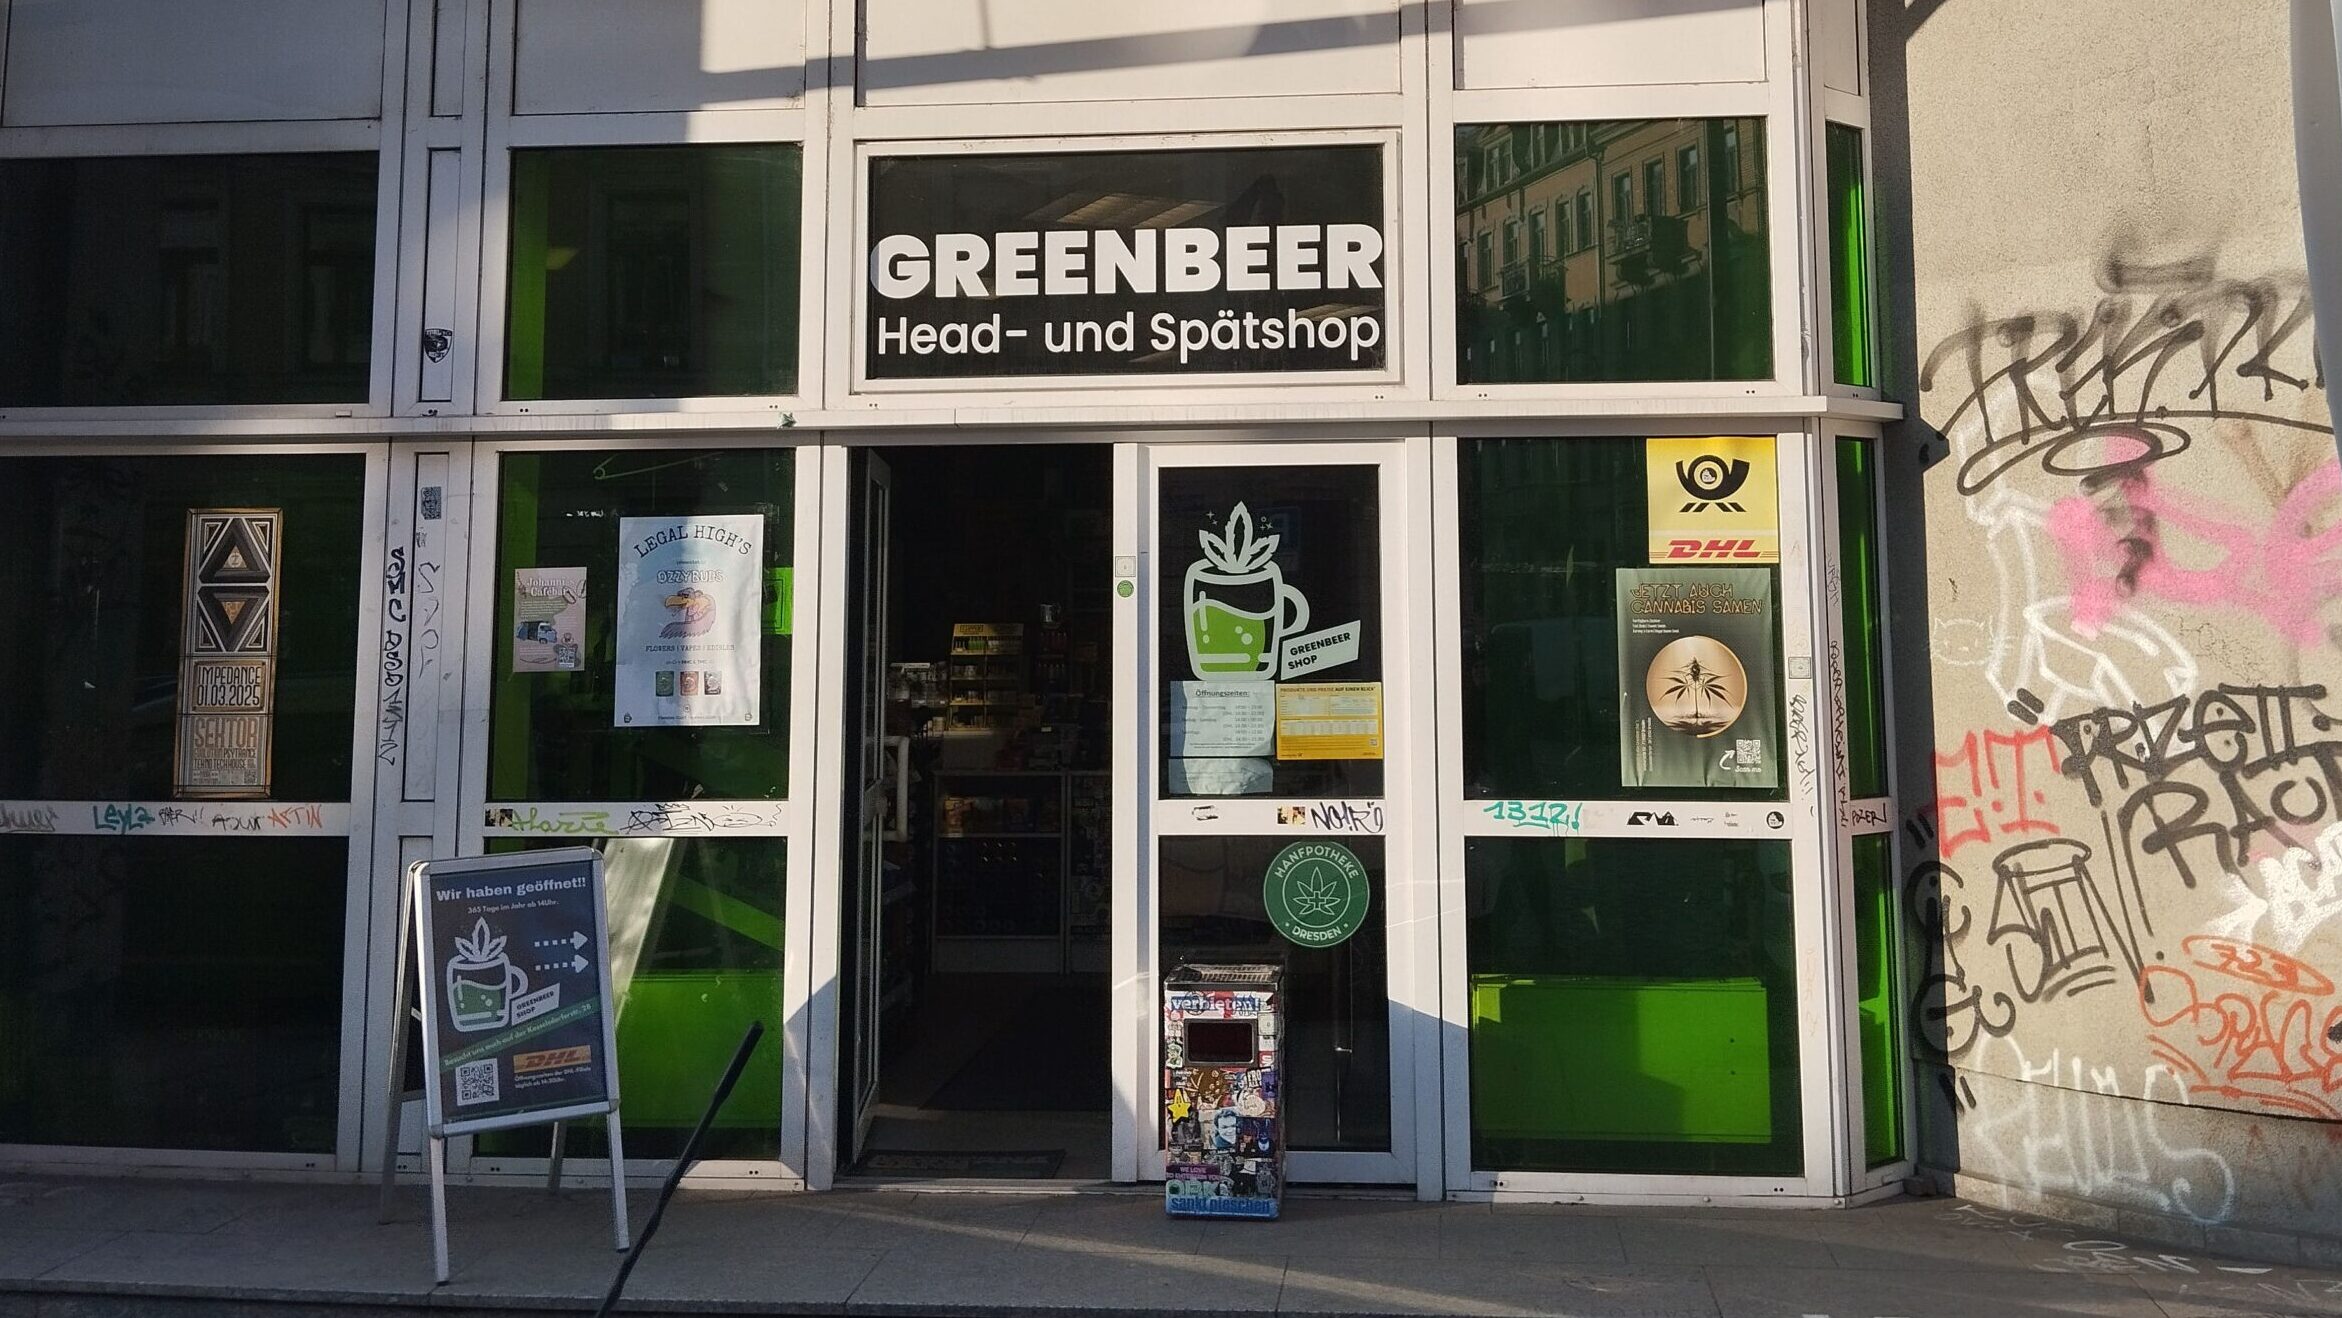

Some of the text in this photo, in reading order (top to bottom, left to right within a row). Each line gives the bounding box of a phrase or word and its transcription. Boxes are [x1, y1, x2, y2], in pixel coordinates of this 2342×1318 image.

[870, 223, 1383, 300] GREENBEER
[878, 309, 1381, 364] Head- und Spätshop
[633, 524, 752, 558] LEGAL HIGH'S
[1667, 539, 1761, 559] DHL
[1630, 582, 1734, 599] JETZT AUCH
[1630, 598, 1763, 616] CANNABIS SAMEN
[1289, 631, 1351, 657] GREENBEER
[1287, 653, 1318, 671] SHOP
[199, 666, 262, 685] IMPEDANCE
[196, 685, 261, 706] 01.03.2025
[1274, 845, 1360, 879] HANFPOTHEKE
[436, 877, 586, 902] Wir haben geöffnet!!
[1291, 926, 1343, 941] DRESDEN
[516, 990, 554, 1010] GREENBEER
[1171, 995, 1260, 1011] verbieten!
[516, 1006, 536, 1019] SHOP
[526, 1049, 583, 1068] DHL
